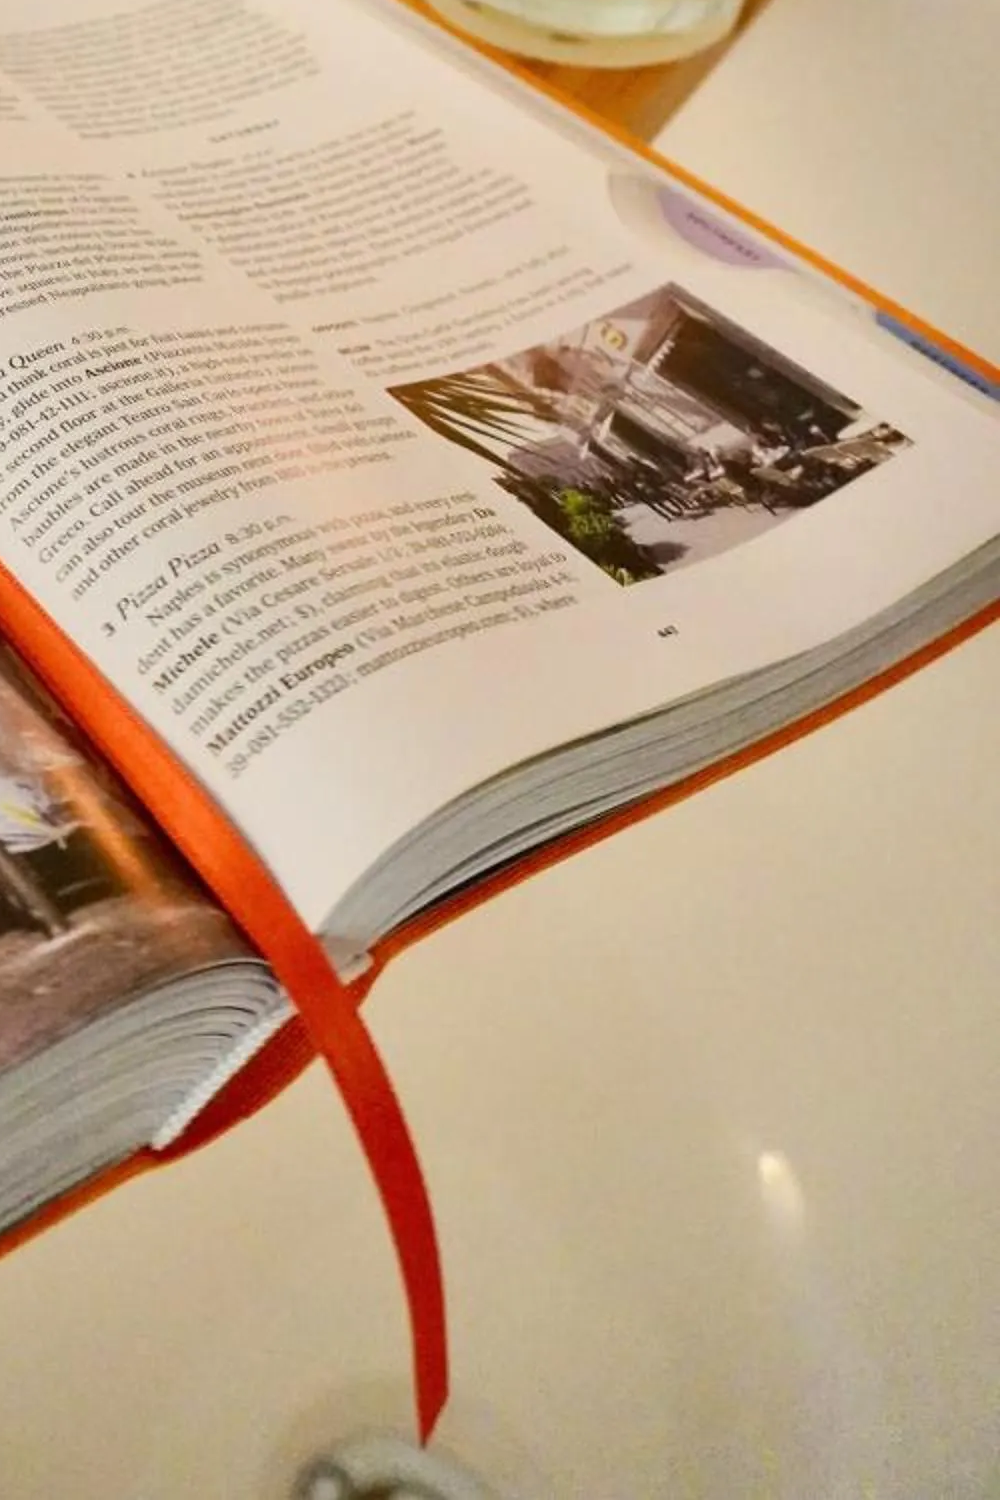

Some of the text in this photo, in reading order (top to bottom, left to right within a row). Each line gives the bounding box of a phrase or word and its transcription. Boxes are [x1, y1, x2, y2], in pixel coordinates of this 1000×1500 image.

[0, 266, 24, 280] the
[25, 259, 72, 273] Piazza
[18, 274, 73, 293] squares
[7, 368, 48, 395] think
[49, 352, 87, 374] coral
[90, 347, 102, 358] is
[104, 341, 129, 356] just
[130, 336, 150, 347] for
[9, 340, 66, 369] Queen
[11, 390, 49, 419] glide
[51, 374, 83, 393] into
[84, 356, 142, 379] Ascione
[5, 429, 59, 473] second
[59, 409, 98, 433] floor
[102, 400, 118, 414] at
[119, 390, 144, 408] the
[144, 380, 201, 400] Galleria
[9, 464, 82, 532] Ascione's
[80, 431, 149, 470] lustrous
[149, 418, 187, 439] coral
[32, 454, 58, 479] the
[60, 421, 118, 459] elegant
[118, 402, 171, 425] Teatro
[172, 393, 201, 408] San
[201, 385, 238, 400] Carlo
[22, 421, 254, 549] baubles are made in the nearby
[37, 516, 93, 565] Greco.
[89, 489, 122, 518] Call
[125, 464, 175, 496] ahead
[175, 457, 203, 473] for
[203, 447, 221, 462] an
[84, 526, 114, 556] also
[113, 502, 151, 531] tour
[148, 489, 176, 507] the
[178, 464, 242, 493] museum
[72, 474, 279, 600] and other coral jewelry from
[144, 580, 207, 627] Naples
[204, 570, 223, 585] is
[222, 527, 318, 574] synonymous
[101, 622, 117, 637] 3
[115, 575, 169, 621] Pizza
[167, 542, 222, 578] Pizza
[136, 635, 172, 676] dent
[171, 614, 202, 641] has
[204, 605, 217, 618] a
[214, 568, 281, 609] favorite.
[280, 550, 326, 571] Many
[153, 631, 221, 694] Michele
[222, 605, 263, 635] (Via
[261, 576, 321, 609] Cesare
[171, 617, 297, 716] damichele.net;
[189, 679, 246, 736] makes
[244, 658, 277, 684] the
[276, 624, 331, 665] pizzas
[331, 604, 380, 630] easier
[205, 681, 281, 756] Mattozzi
[280, 639, 356, 690] Europeo
